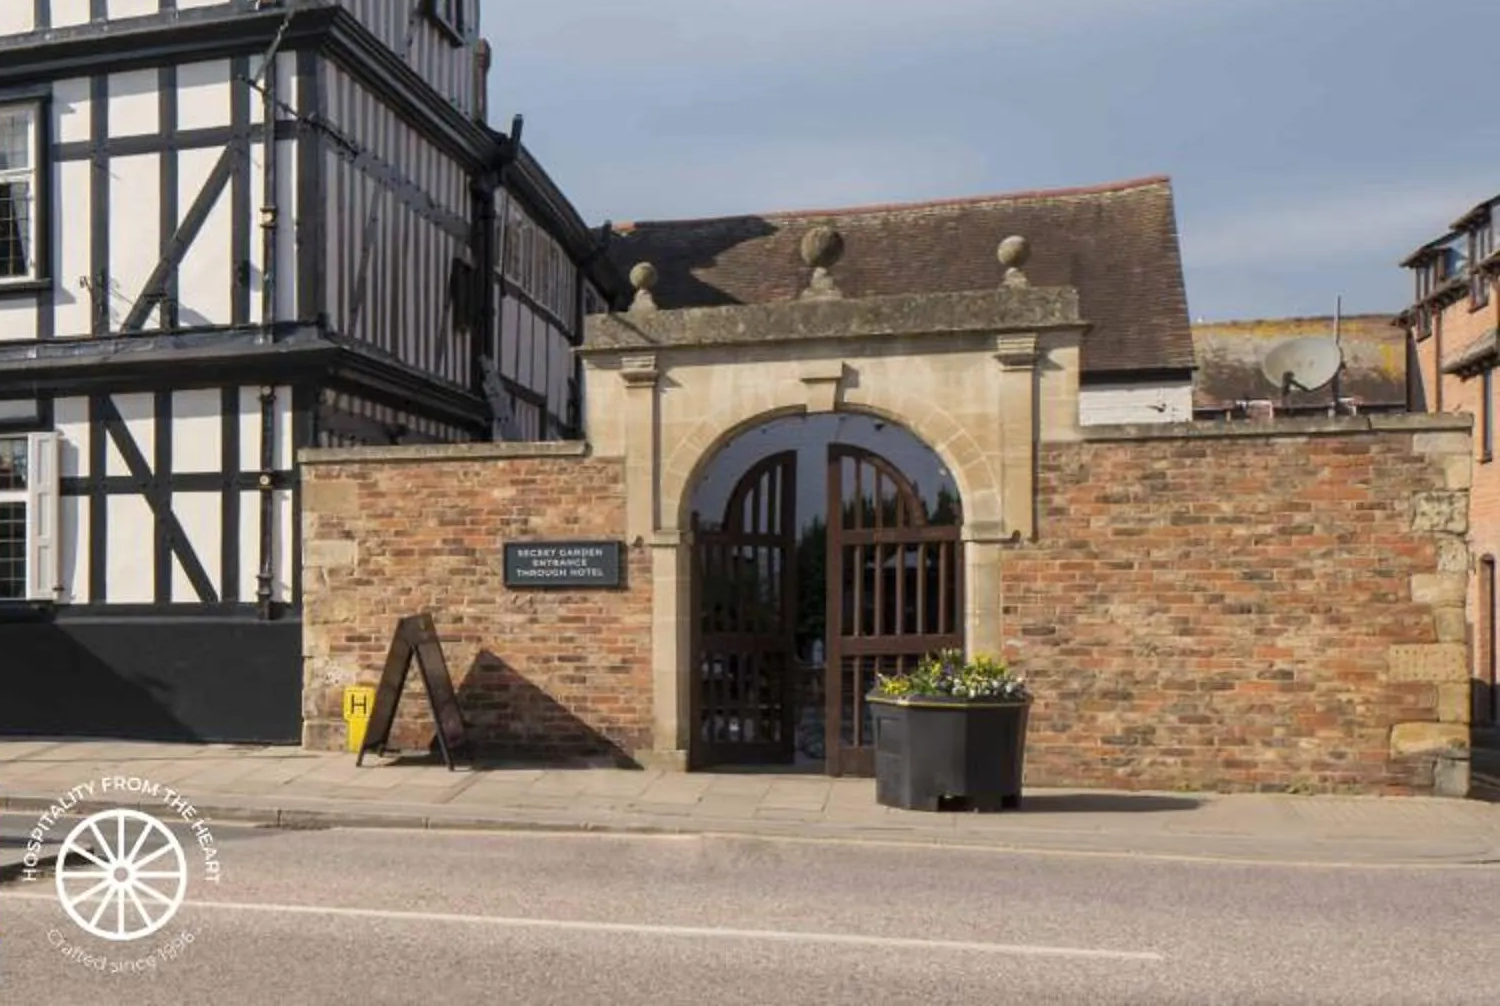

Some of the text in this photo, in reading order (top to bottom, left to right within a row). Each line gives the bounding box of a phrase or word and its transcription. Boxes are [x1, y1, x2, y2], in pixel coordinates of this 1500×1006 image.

[559, 548, 603, 557] GARDEN
[532, 558, 587, 567] ENTRANCE
[516, 567, 604, 577] THROUGH HOTEL
[351, 694, 367, 714] H
